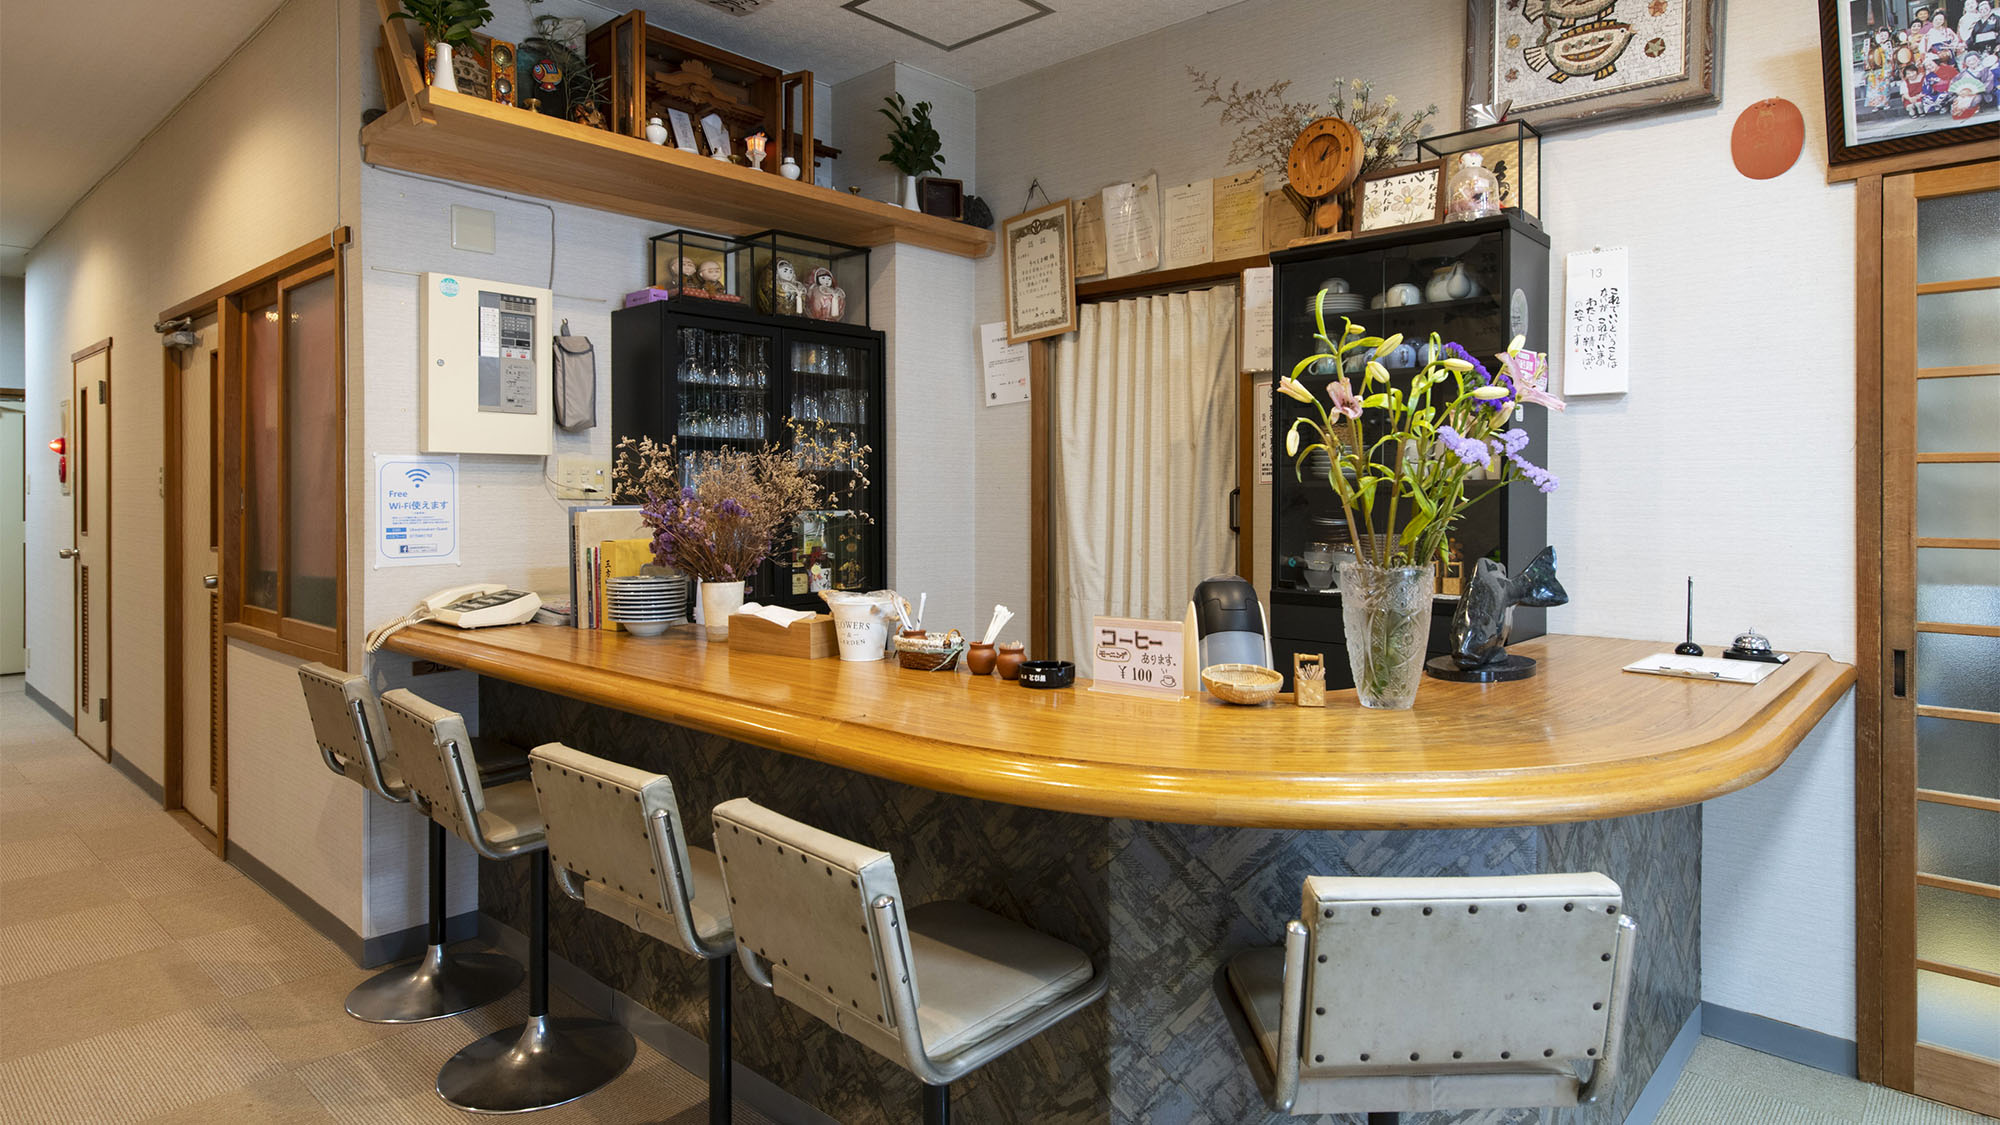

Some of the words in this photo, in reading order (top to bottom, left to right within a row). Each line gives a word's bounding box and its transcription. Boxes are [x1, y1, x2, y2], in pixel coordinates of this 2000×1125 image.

[1590, 268, 1603, 279] 13
[388, 490, 408, 498] Free
[1101, 629, 1162, 650] コーヒー
[1099, 650, 1128, 660] モーニング
[1141, 653, 1177, 667] あります。
